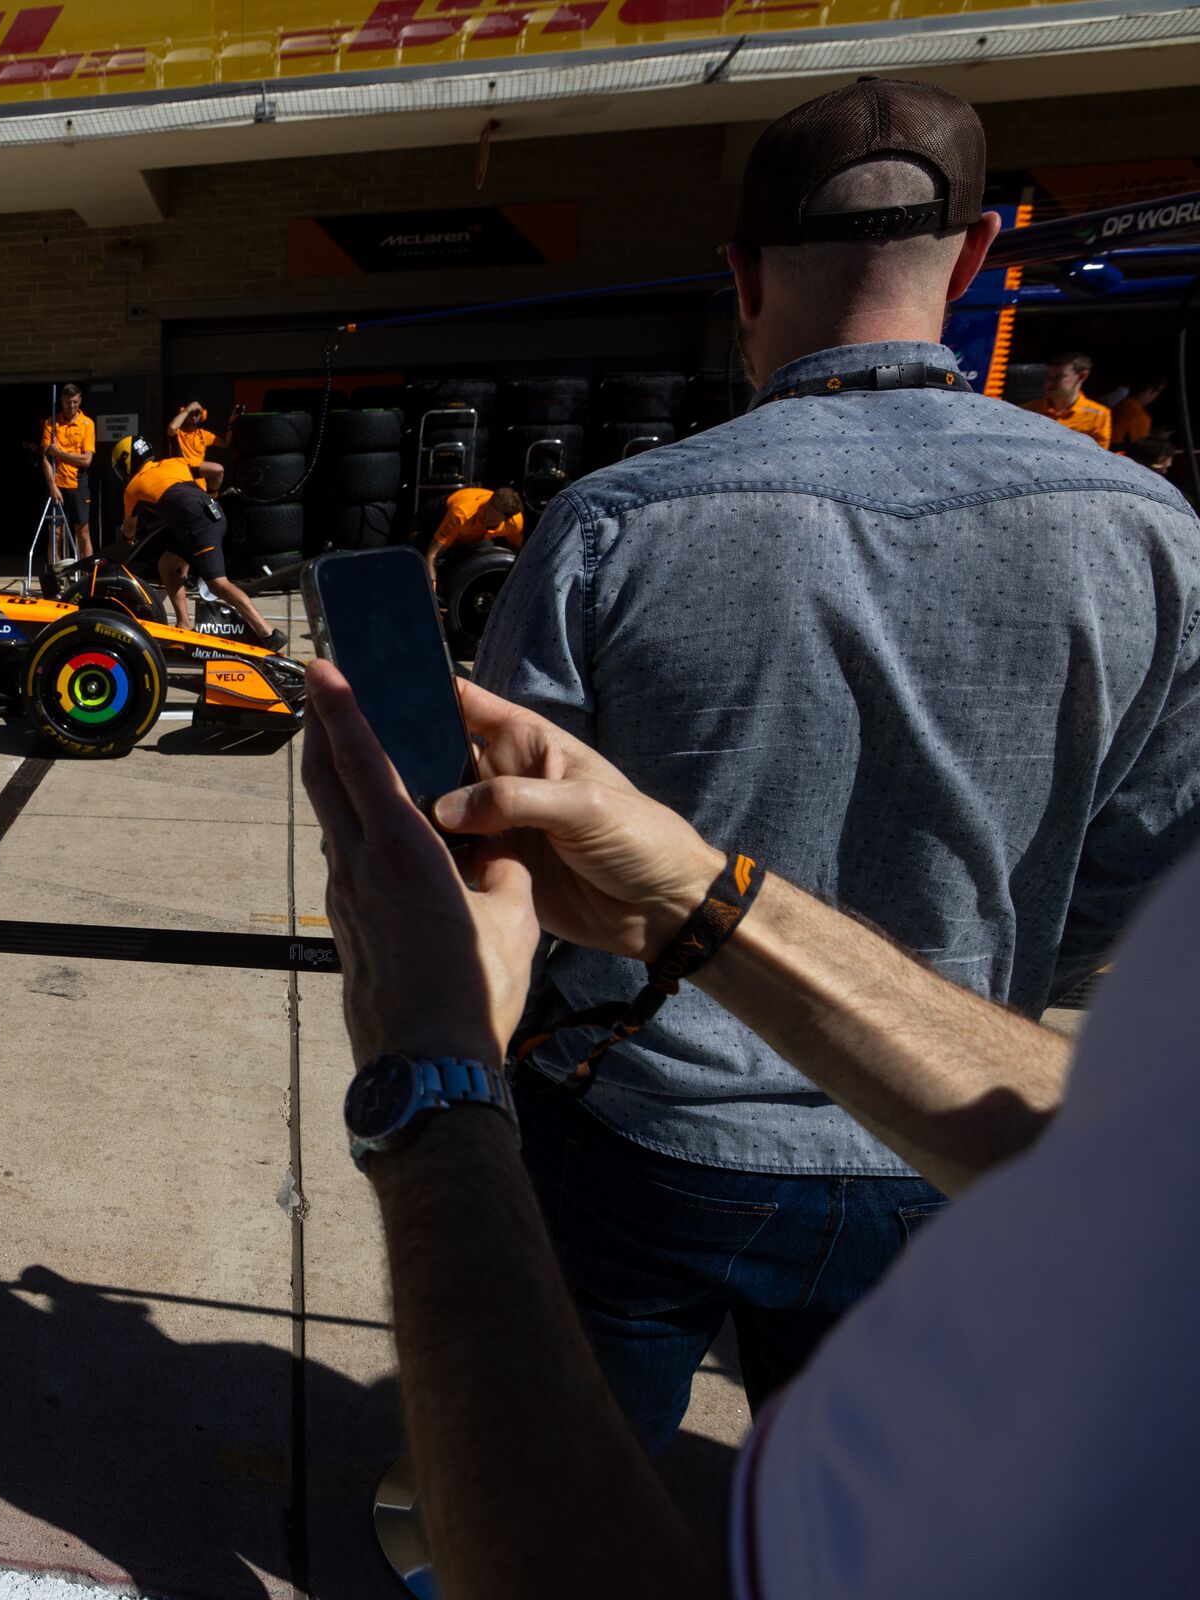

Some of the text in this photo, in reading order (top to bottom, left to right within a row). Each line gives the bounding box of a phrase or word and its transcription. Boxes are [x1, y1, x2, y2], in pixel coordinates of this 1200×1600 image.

[1101, 200, 1200, 237] DP WORL
[379, 231, 472, 248] McLaren
[95, 623, 132, 644] PIRELLI
[195, 623, 244, 634] ARROW
[216, 673, 246, 682] VELO
